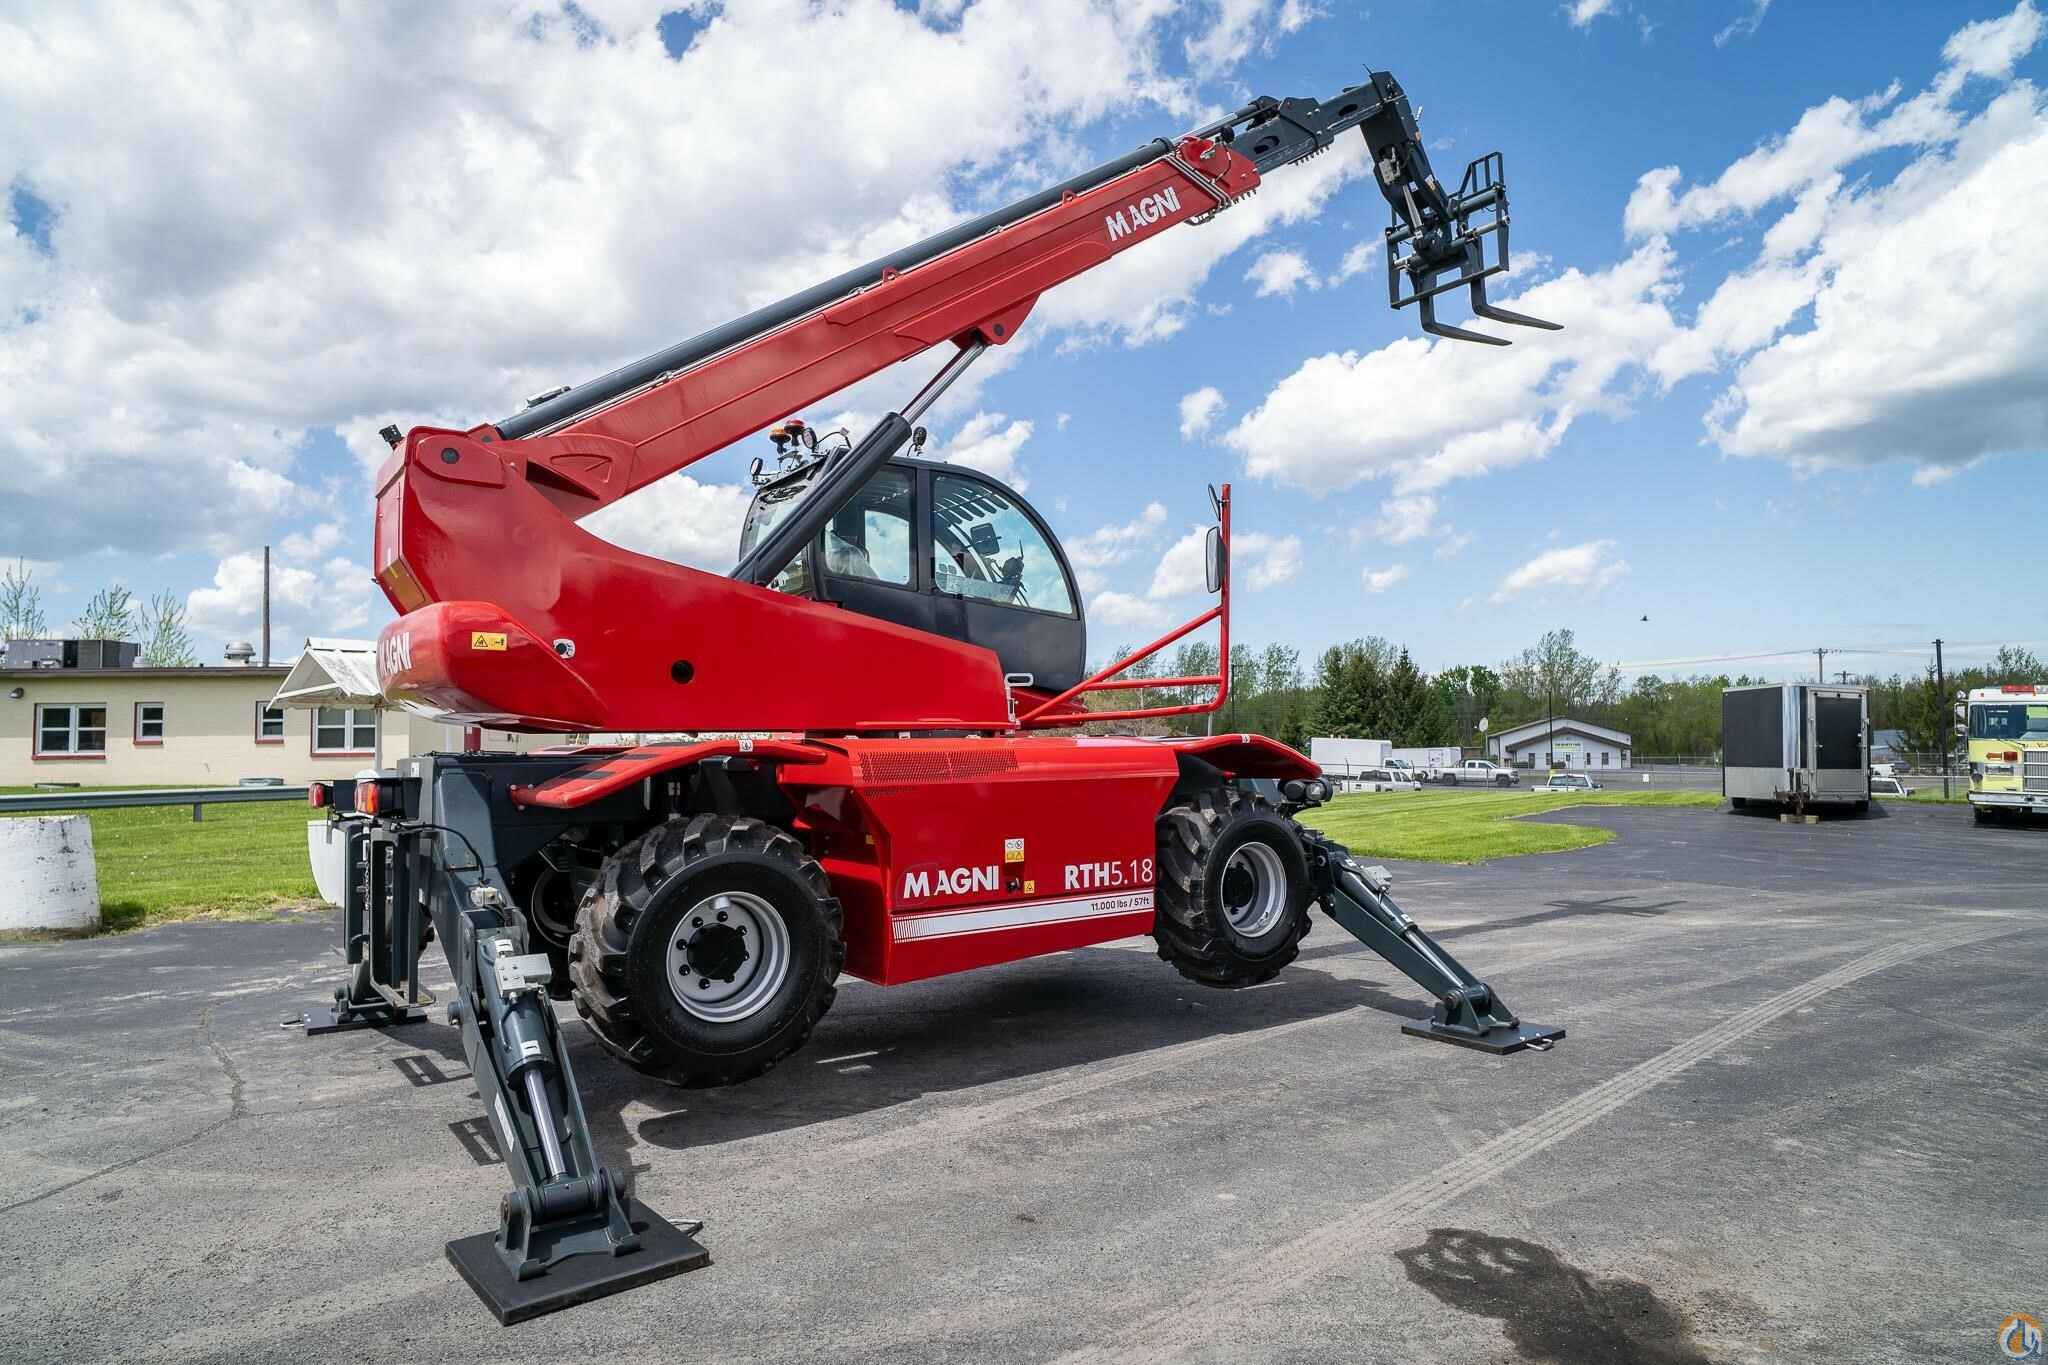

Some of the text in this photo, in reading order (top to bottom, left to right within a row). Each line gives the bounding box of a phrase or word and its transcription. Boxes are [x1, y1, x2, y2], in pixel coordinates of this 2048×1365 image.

[1105, 186, 1181, 241] MAGNI
[903, 865, 999, 899] MAGNI
[1064, 858, 1153, 890] RTH5.18
[1117, 899, 1128, 908] lbs
